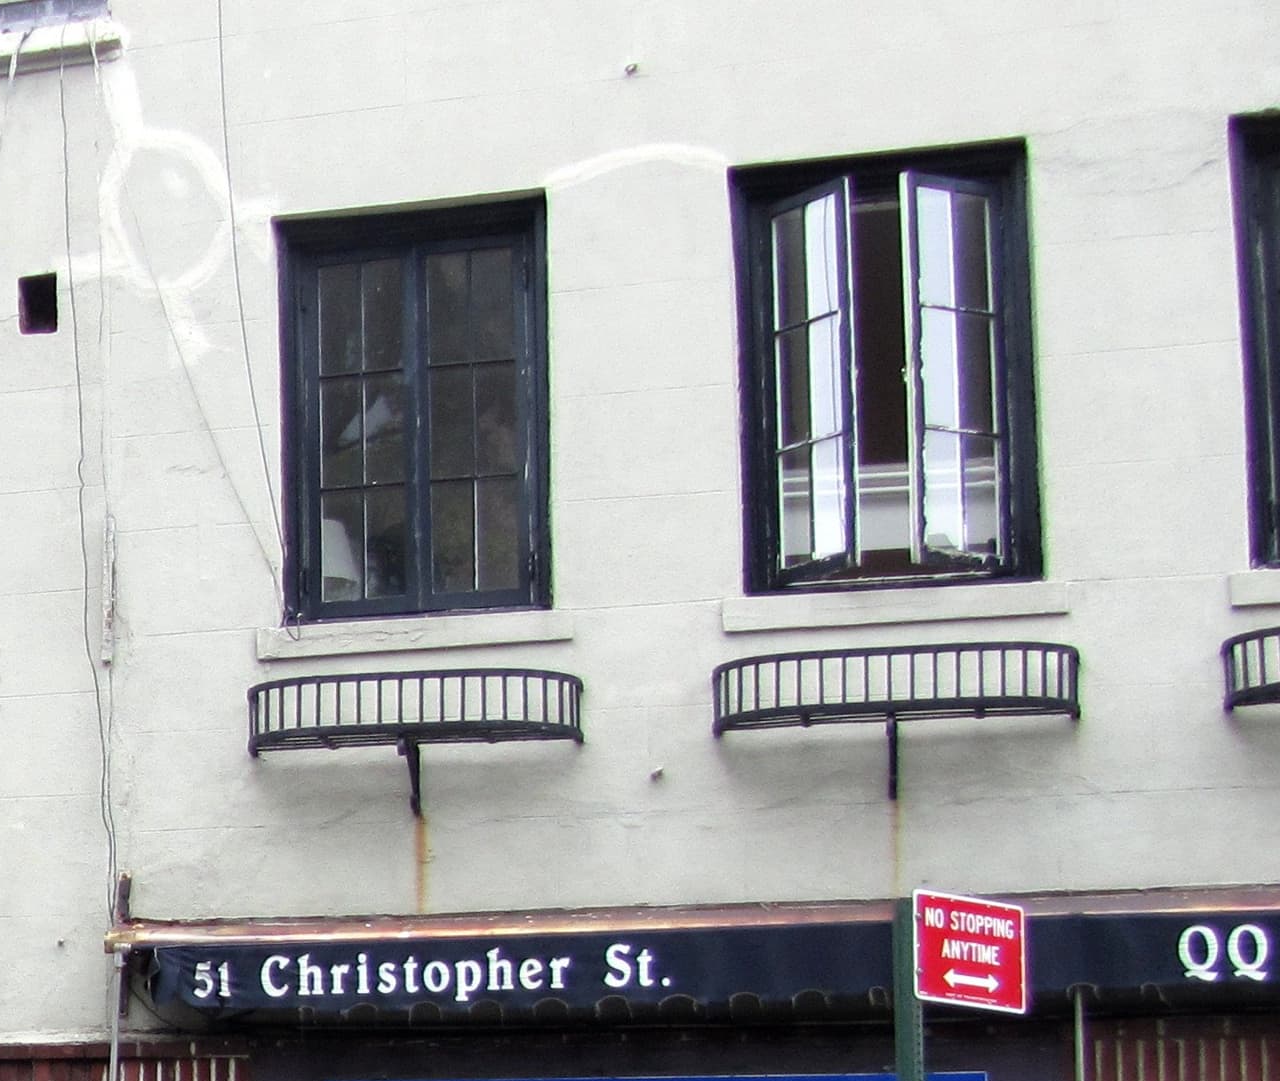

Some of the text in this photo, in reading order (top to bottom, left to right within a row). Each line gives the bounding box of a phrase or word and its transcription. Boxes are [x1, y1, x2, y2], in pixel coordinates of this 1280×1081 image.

[924, 907, 1014, 939] NO STOPPING
[193, 942, 671, 1001] 51 Christopher St.
[941, 939, 1001, 966] ANYTIME
[1177, 923, 1269, 981] QQ
